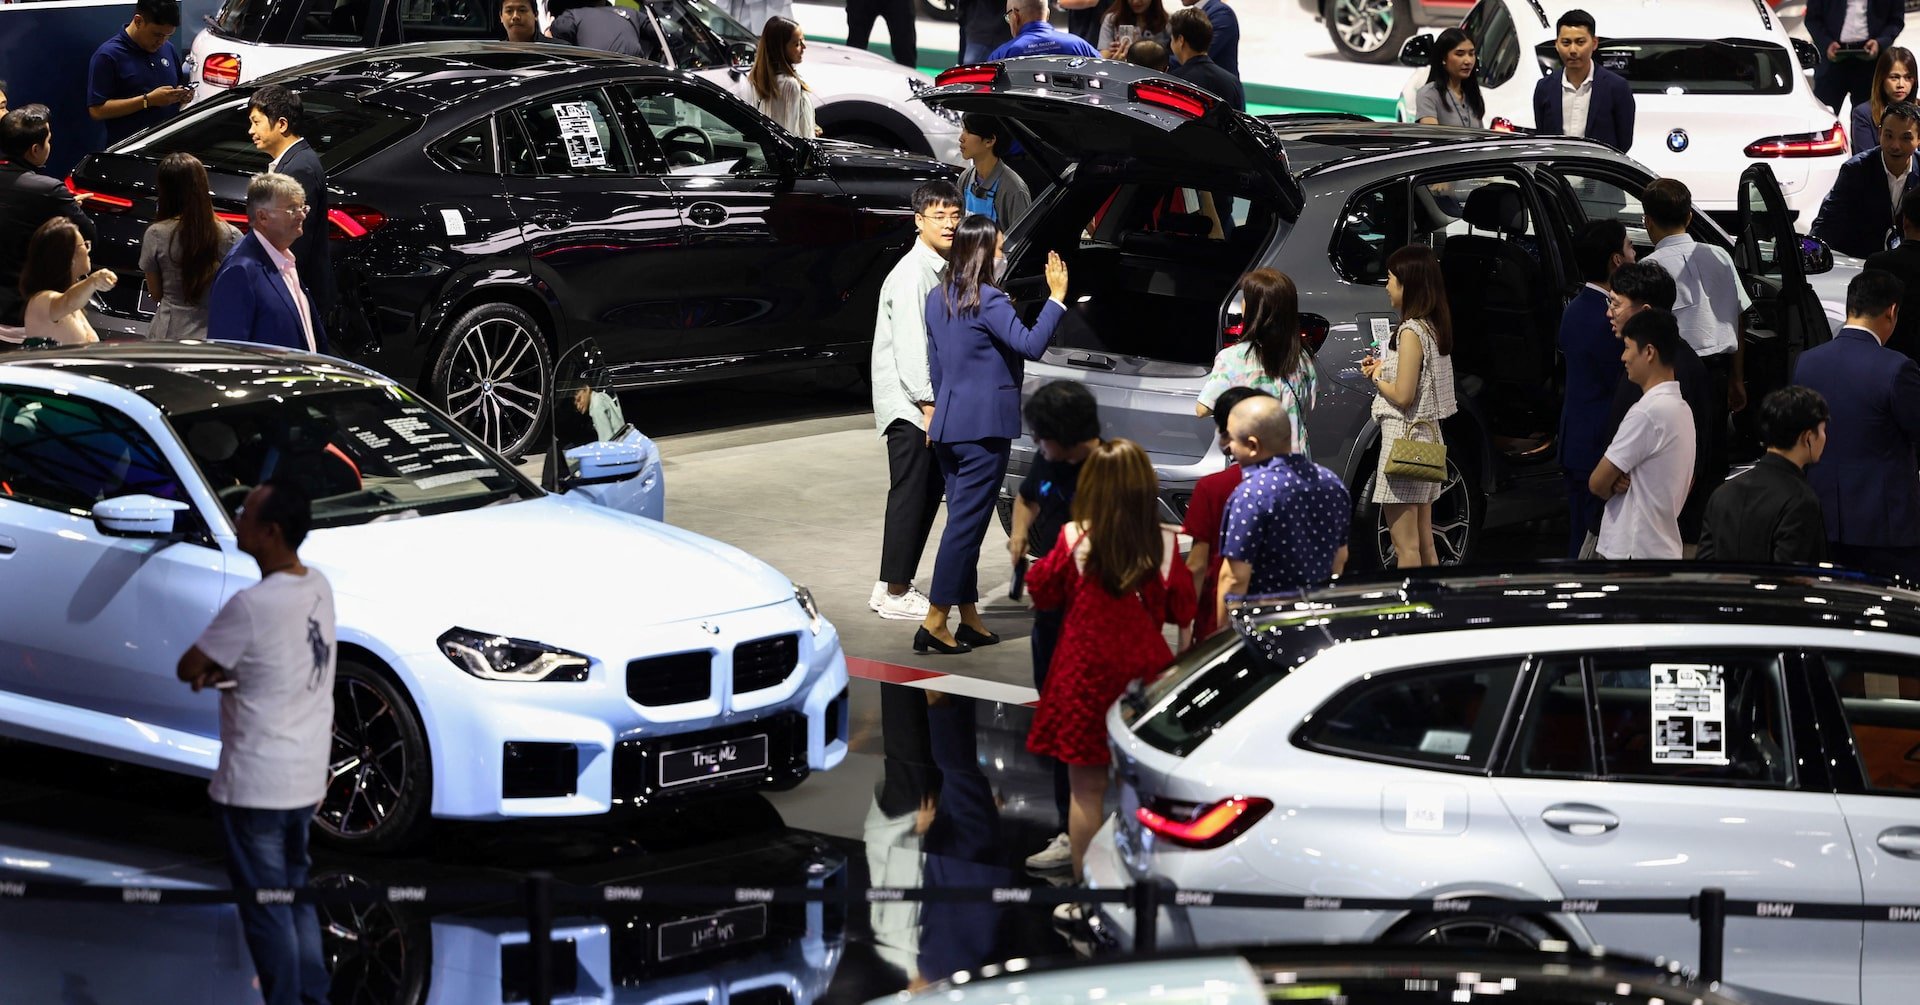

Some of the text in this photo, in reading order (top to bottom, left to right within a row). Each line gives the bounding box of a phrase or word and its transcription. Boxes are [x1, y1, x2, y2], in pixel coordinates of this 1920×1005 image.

[692, 744, 738, 768] THE M2
[0, 882, 26, 896] MW
[122, 888, 162, 903] BMW
[256, 888, 296, 904] BMW
[387, 887, 427, 902] BMW
[604, 886, 643, 901] BMW
[735, 887, 775, 902] BMW
[866, 887, 906, 902] BMW
[992, 888, 1032, 903] BMW
[1175, 890, 1214, 906] BMW
[1304, 895, 1343, 910] BMW
[1433, 898, 1471, 912] BMW
[1561, 899, 1599, 914] BMW
[1757, 901, 1795, 917] BMW
